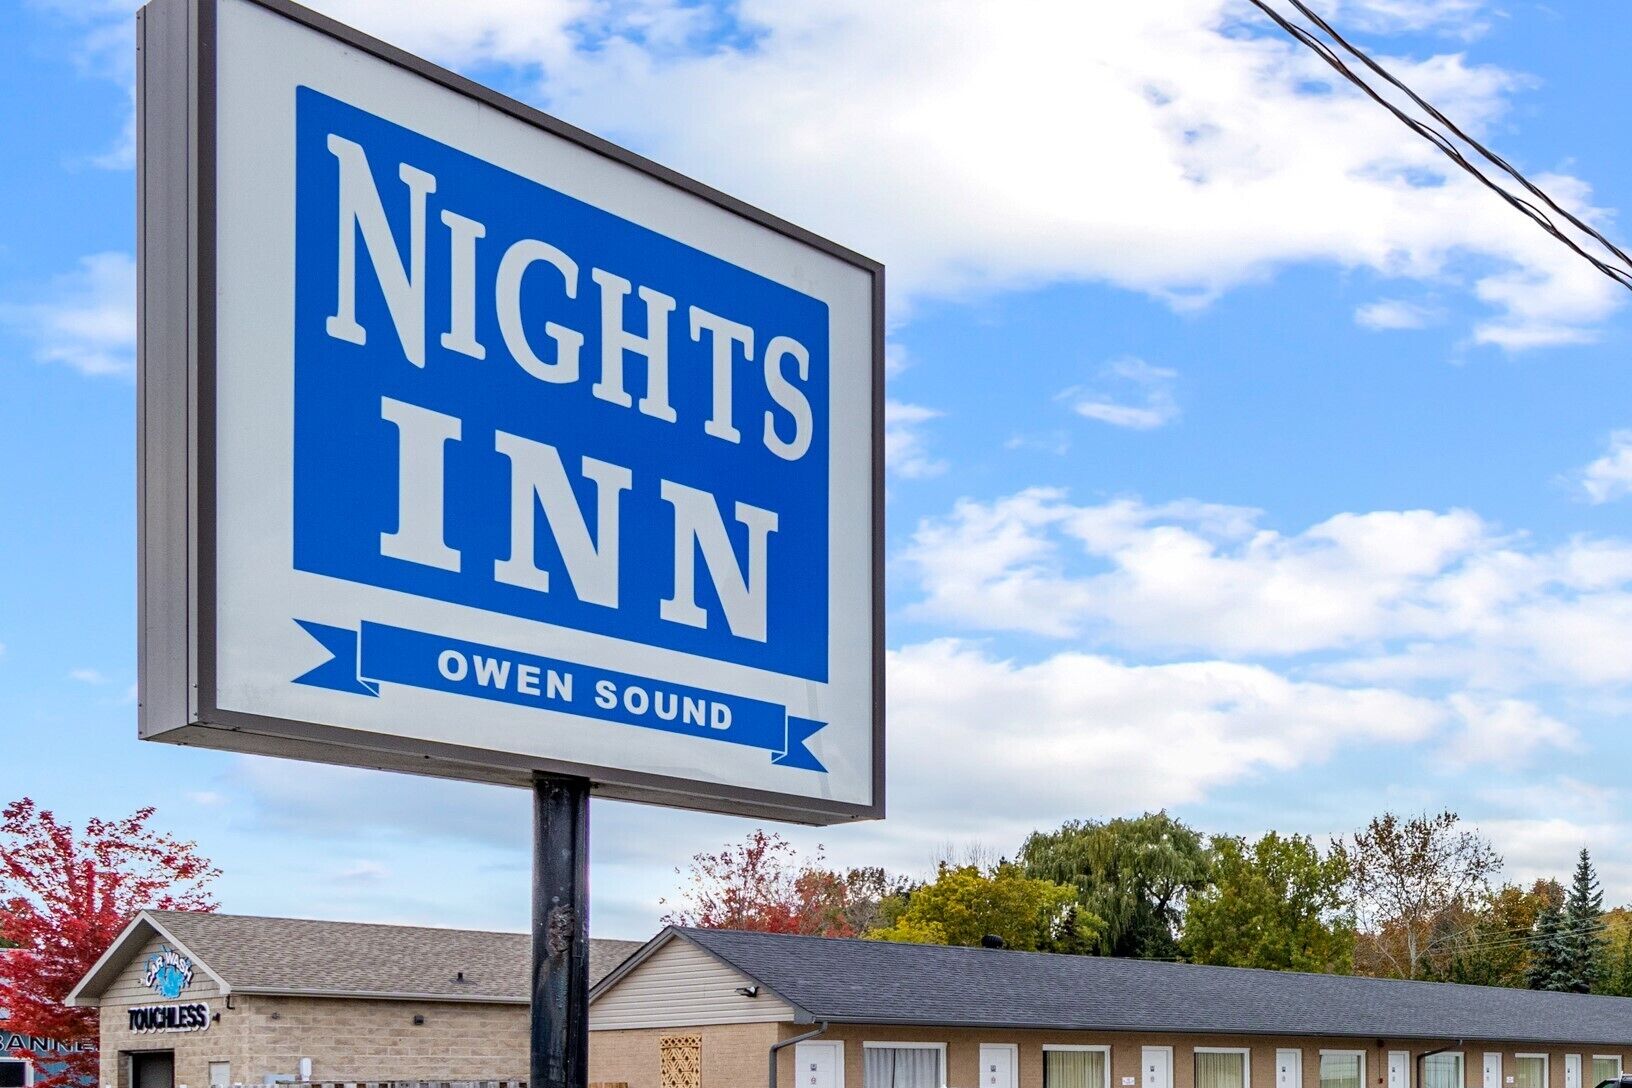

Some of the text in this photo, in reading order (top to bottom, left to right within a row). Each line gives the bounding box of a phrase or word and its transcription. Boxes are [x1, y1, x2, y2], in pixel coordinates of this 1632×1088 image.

[325, 133, 813, 461] NIGHTS
[380, 395, 779, 644] INN
[437, 649, 733, 731] OWEN SOUND
[145, 951, 193, 988] CAR WASH
[127, 1003, 209, 1032] TOUCHLESS
